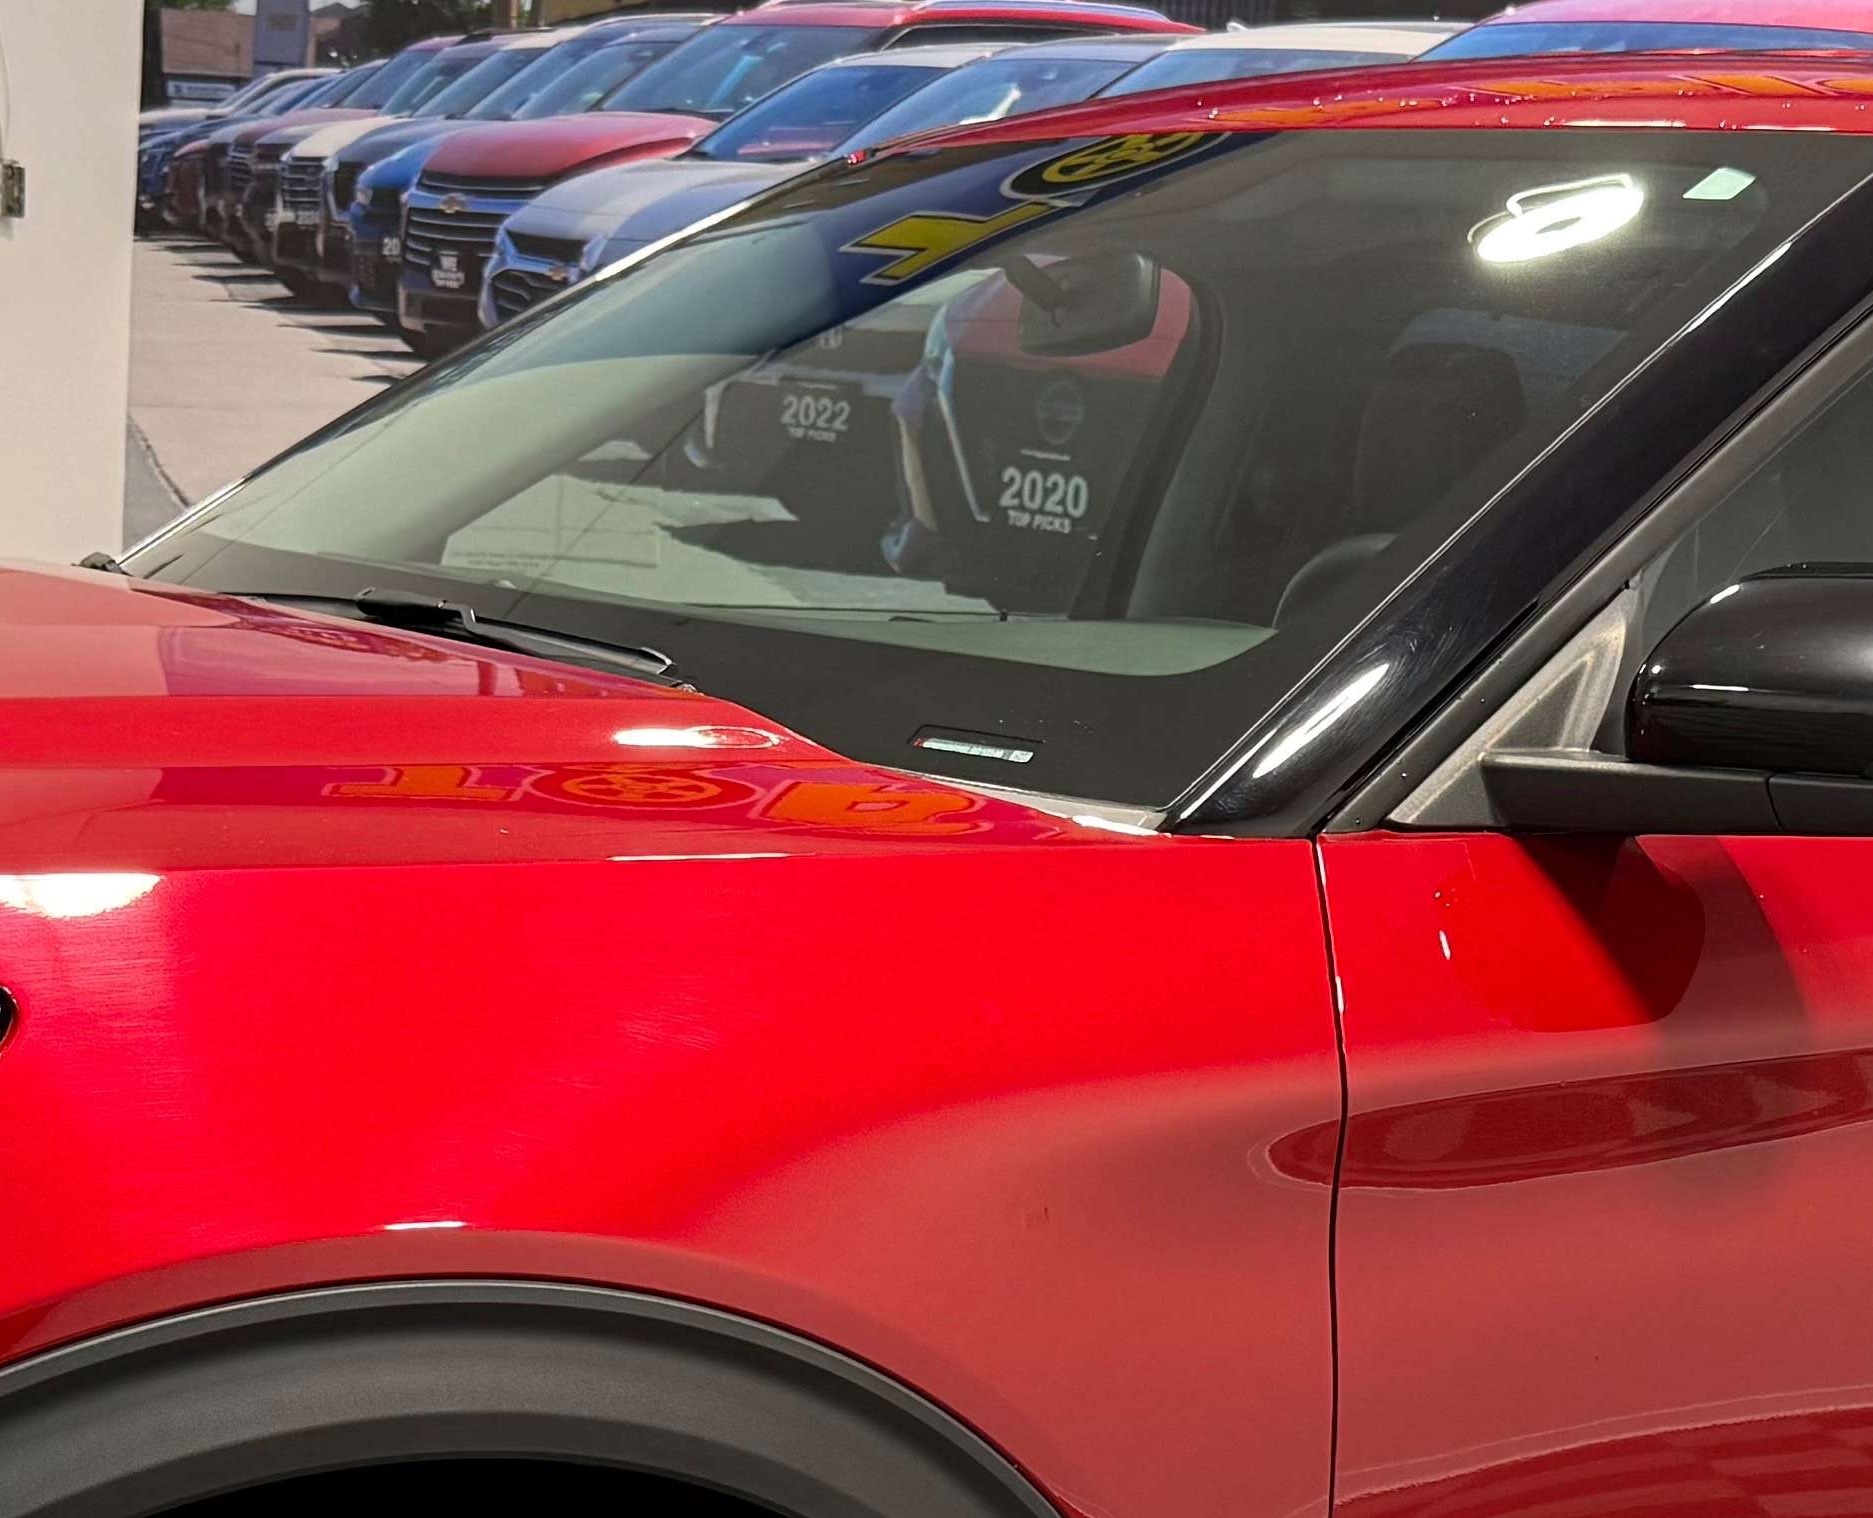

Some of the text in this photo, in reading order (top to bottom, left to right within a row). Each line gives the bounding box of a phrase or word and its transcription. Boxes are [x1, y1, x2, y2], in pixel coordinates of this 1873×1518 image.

[781, 395, 850, 430] 2022
[999, 466, 1088, 518] 2020
[1007, 509, 1071, 534] TOP PICKS
